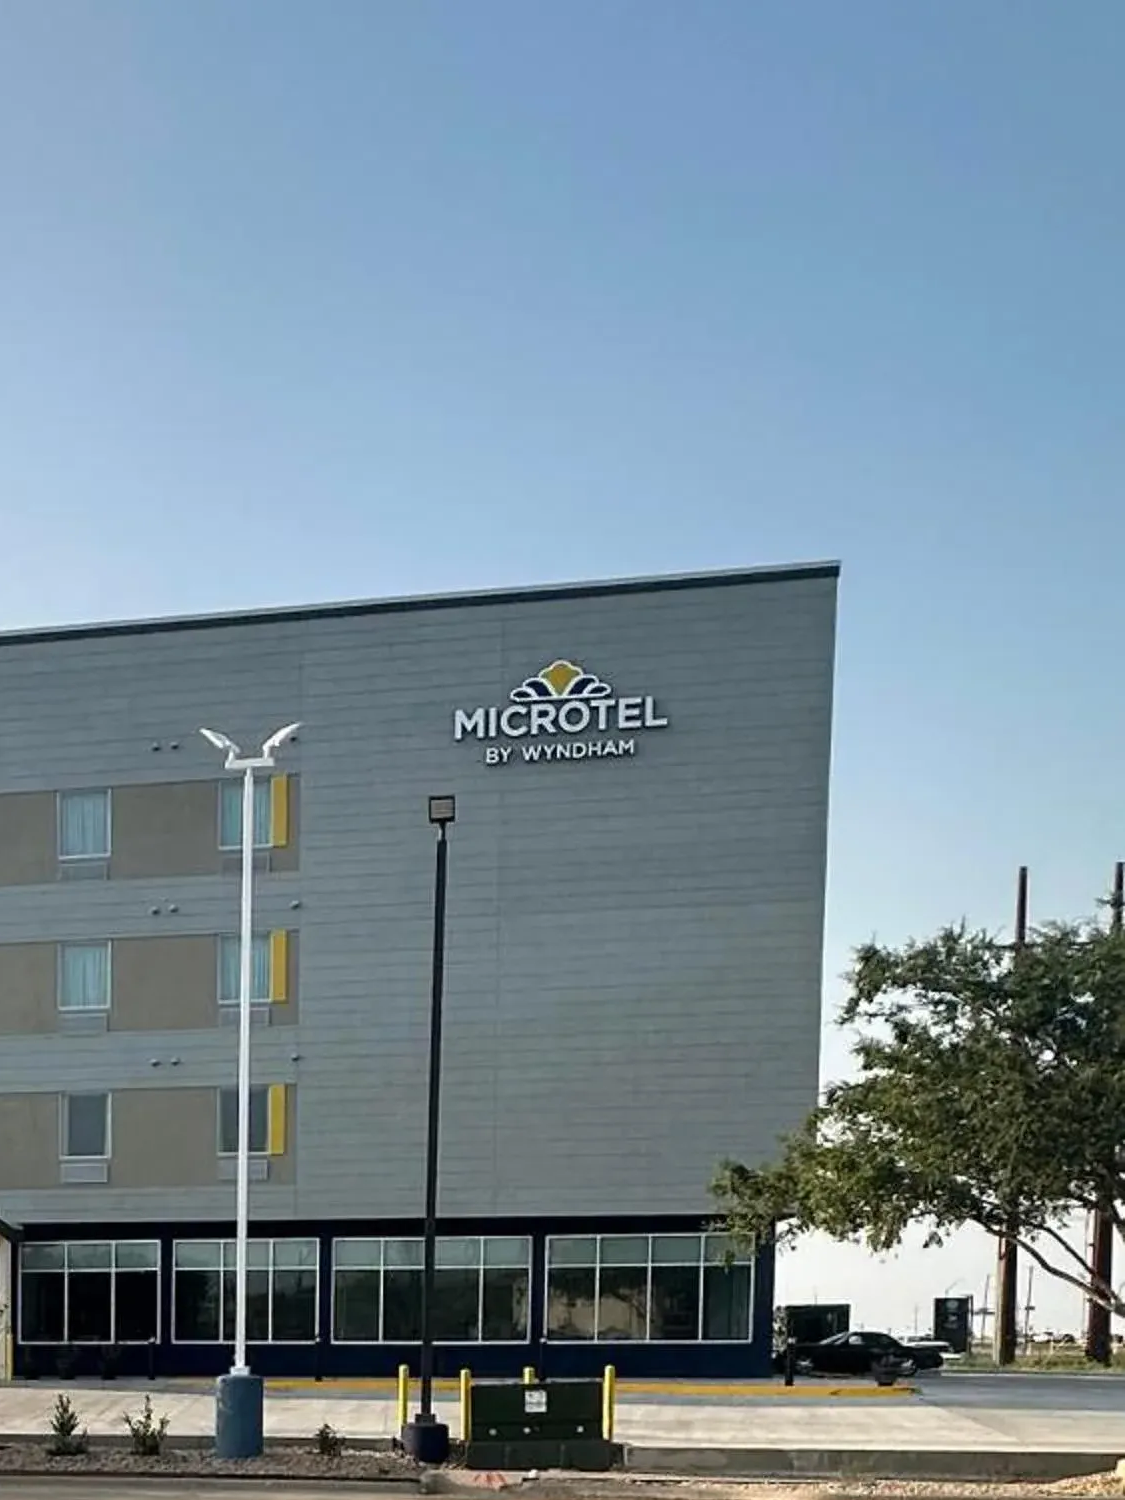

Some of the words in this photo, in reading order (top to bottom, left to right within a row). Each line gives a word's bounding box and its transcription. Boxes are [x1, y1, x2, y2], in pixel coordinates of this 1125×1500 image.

[453, 696, 668, 740] MICROTEL
[485, 748, 512, 764] BY
[522, 739, 635, 762] WYNDHAM
